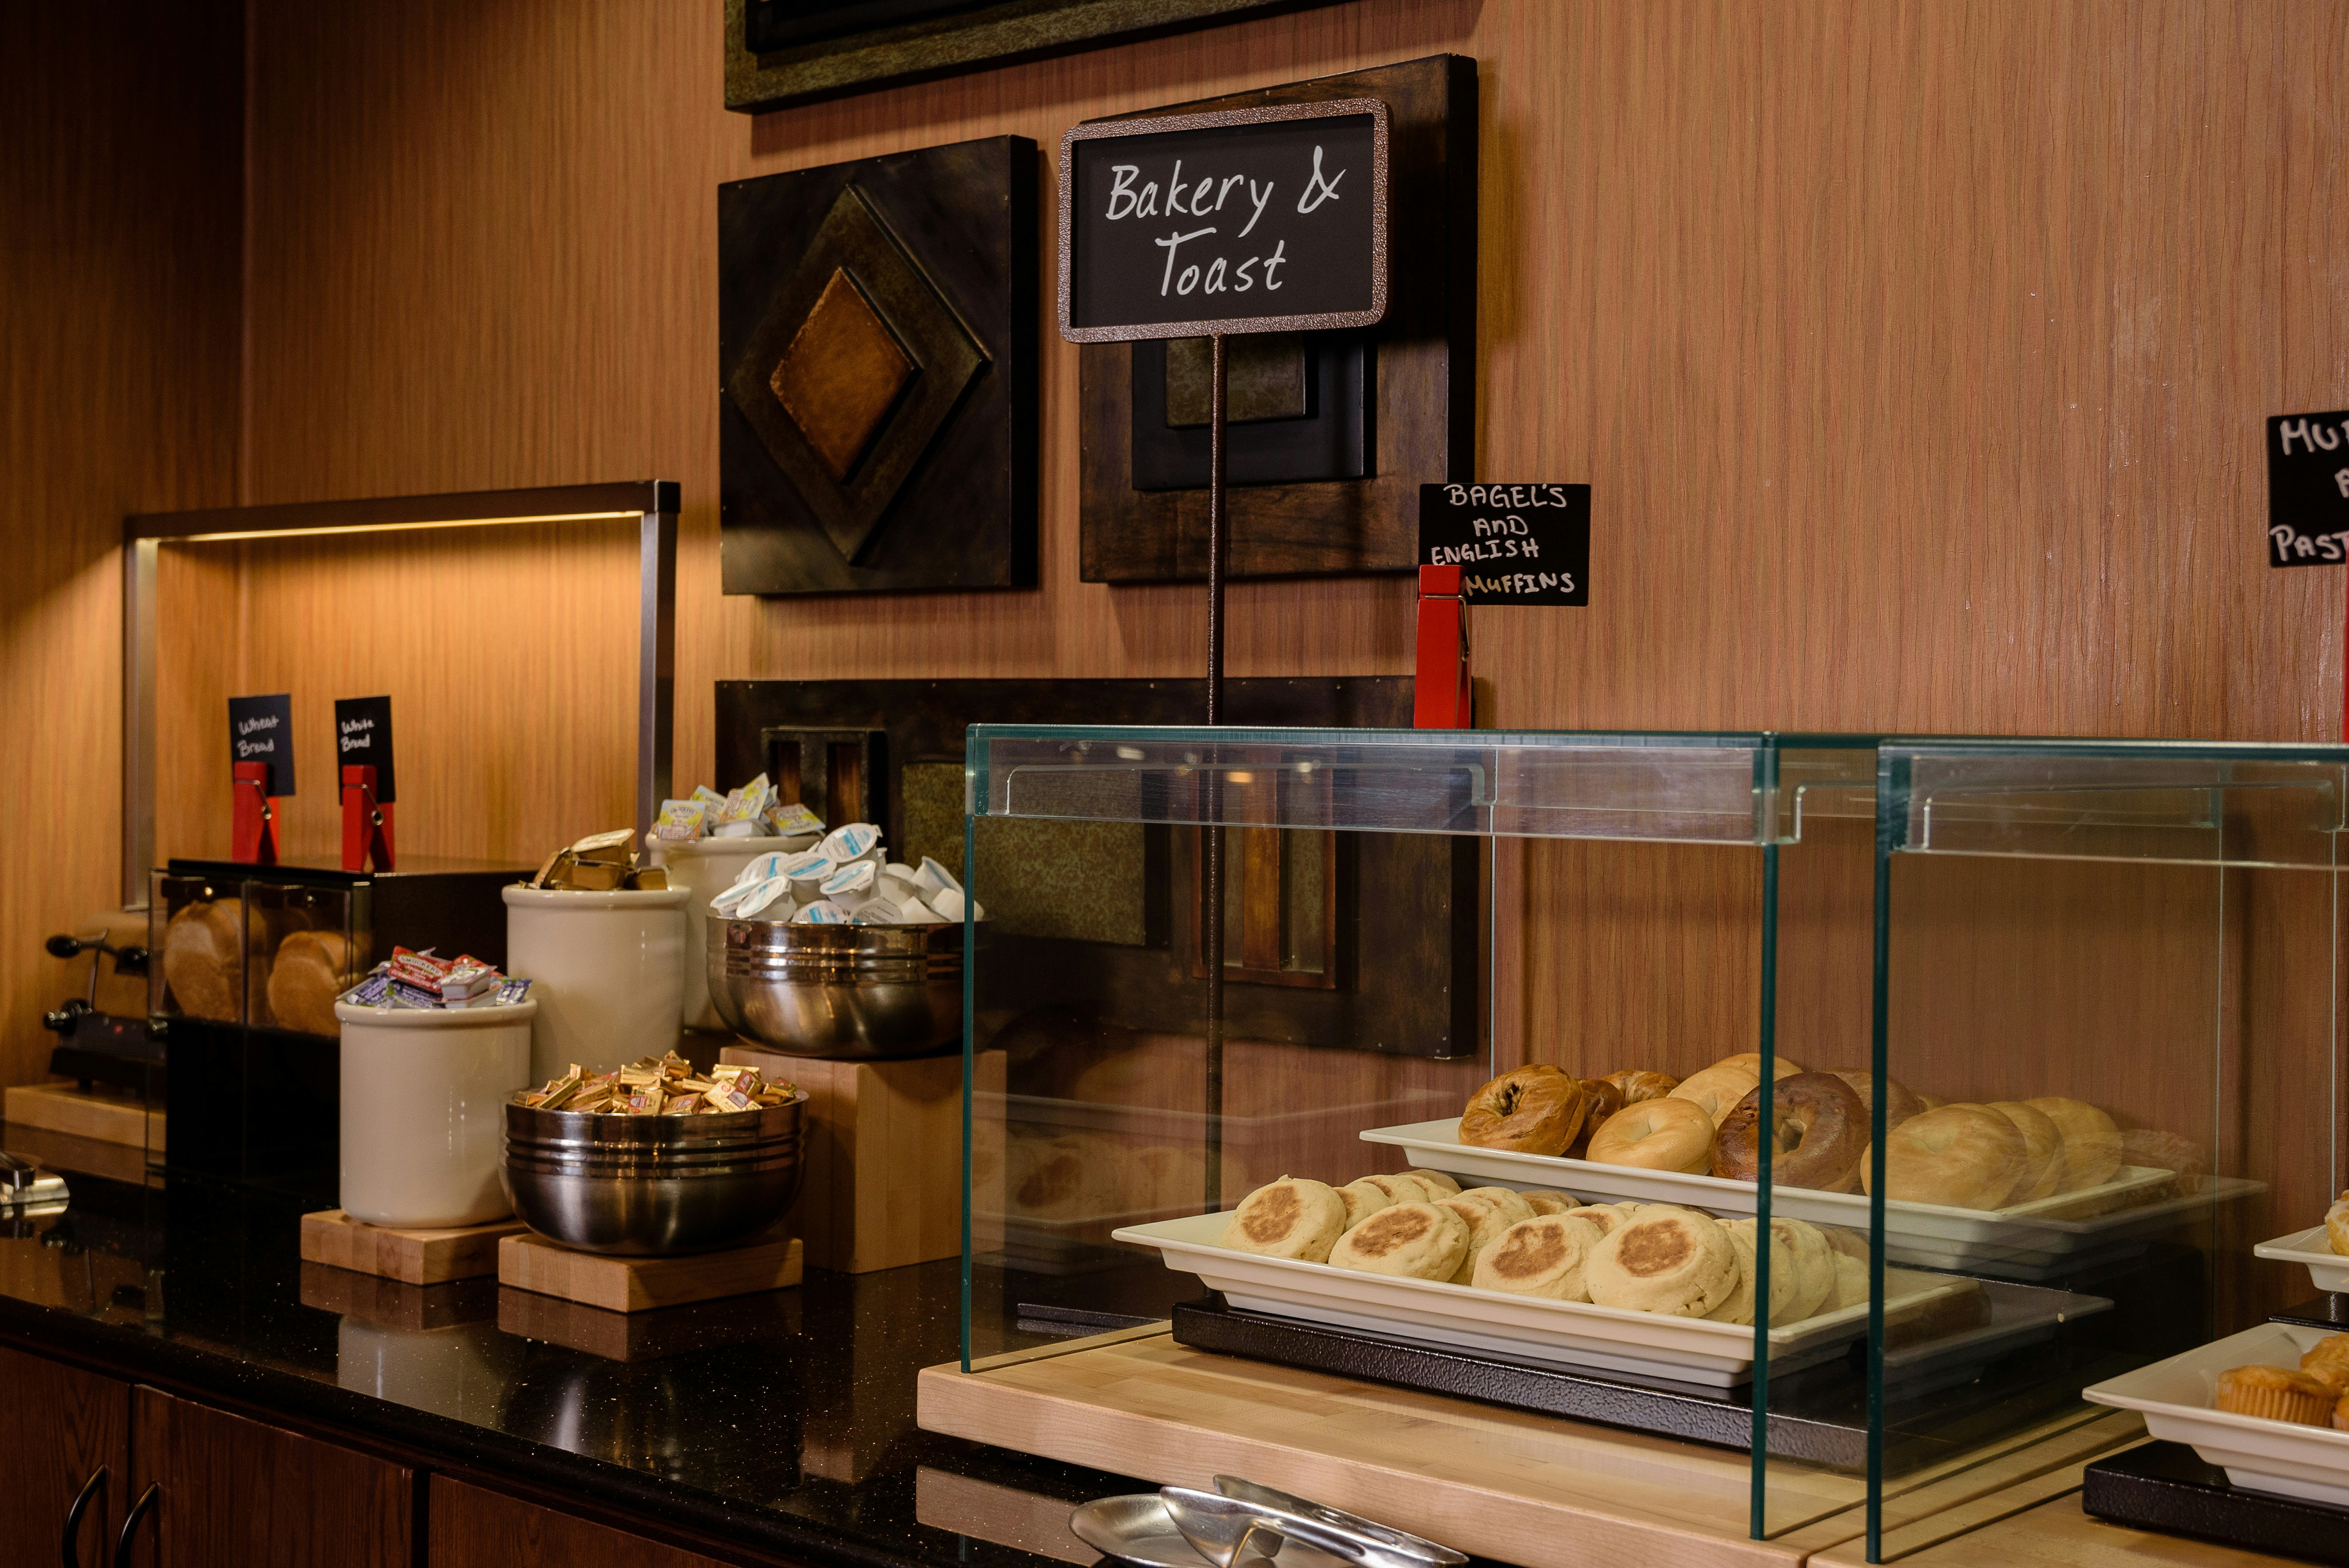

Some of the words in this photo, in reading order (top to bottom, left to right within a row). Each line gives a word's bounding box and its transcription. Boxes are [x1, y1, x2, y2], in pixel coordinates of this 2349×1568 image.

[1106, 160, 1274, 238] Bakery
[1297, 145, 1346, 214] &
[1155, 227, 1286, 296] Toast
[1443, 483, 1567, 508] BAGEL'S
[1431, 538, 1539, 566] ENGLISH
